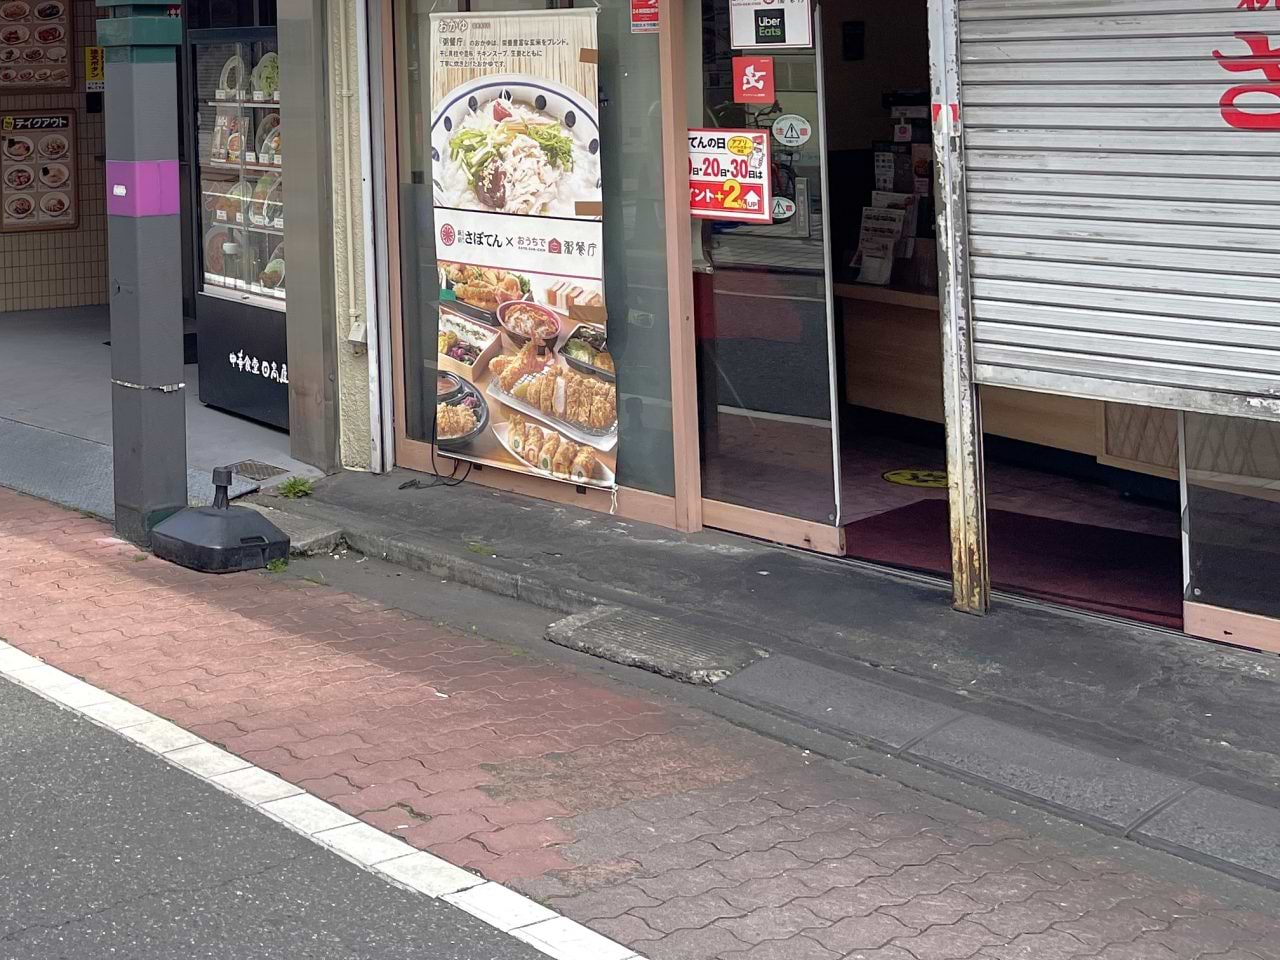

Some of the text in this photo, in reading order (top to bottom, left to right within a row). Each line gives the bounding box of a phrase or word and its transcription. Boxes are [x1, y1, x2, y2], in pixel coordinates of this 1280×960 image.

[439, 19, 468, 33] おかゆ
[758, 16, 781, 26] Uber
[759, 27, 781, 36] Eats
[15, 117, 67, 128] テイクアウト
[464, 230, 503, 248] さぼてん
[517, 235, 547, 248] おうちで
[229, 349, 260, 375] 中華食堂
